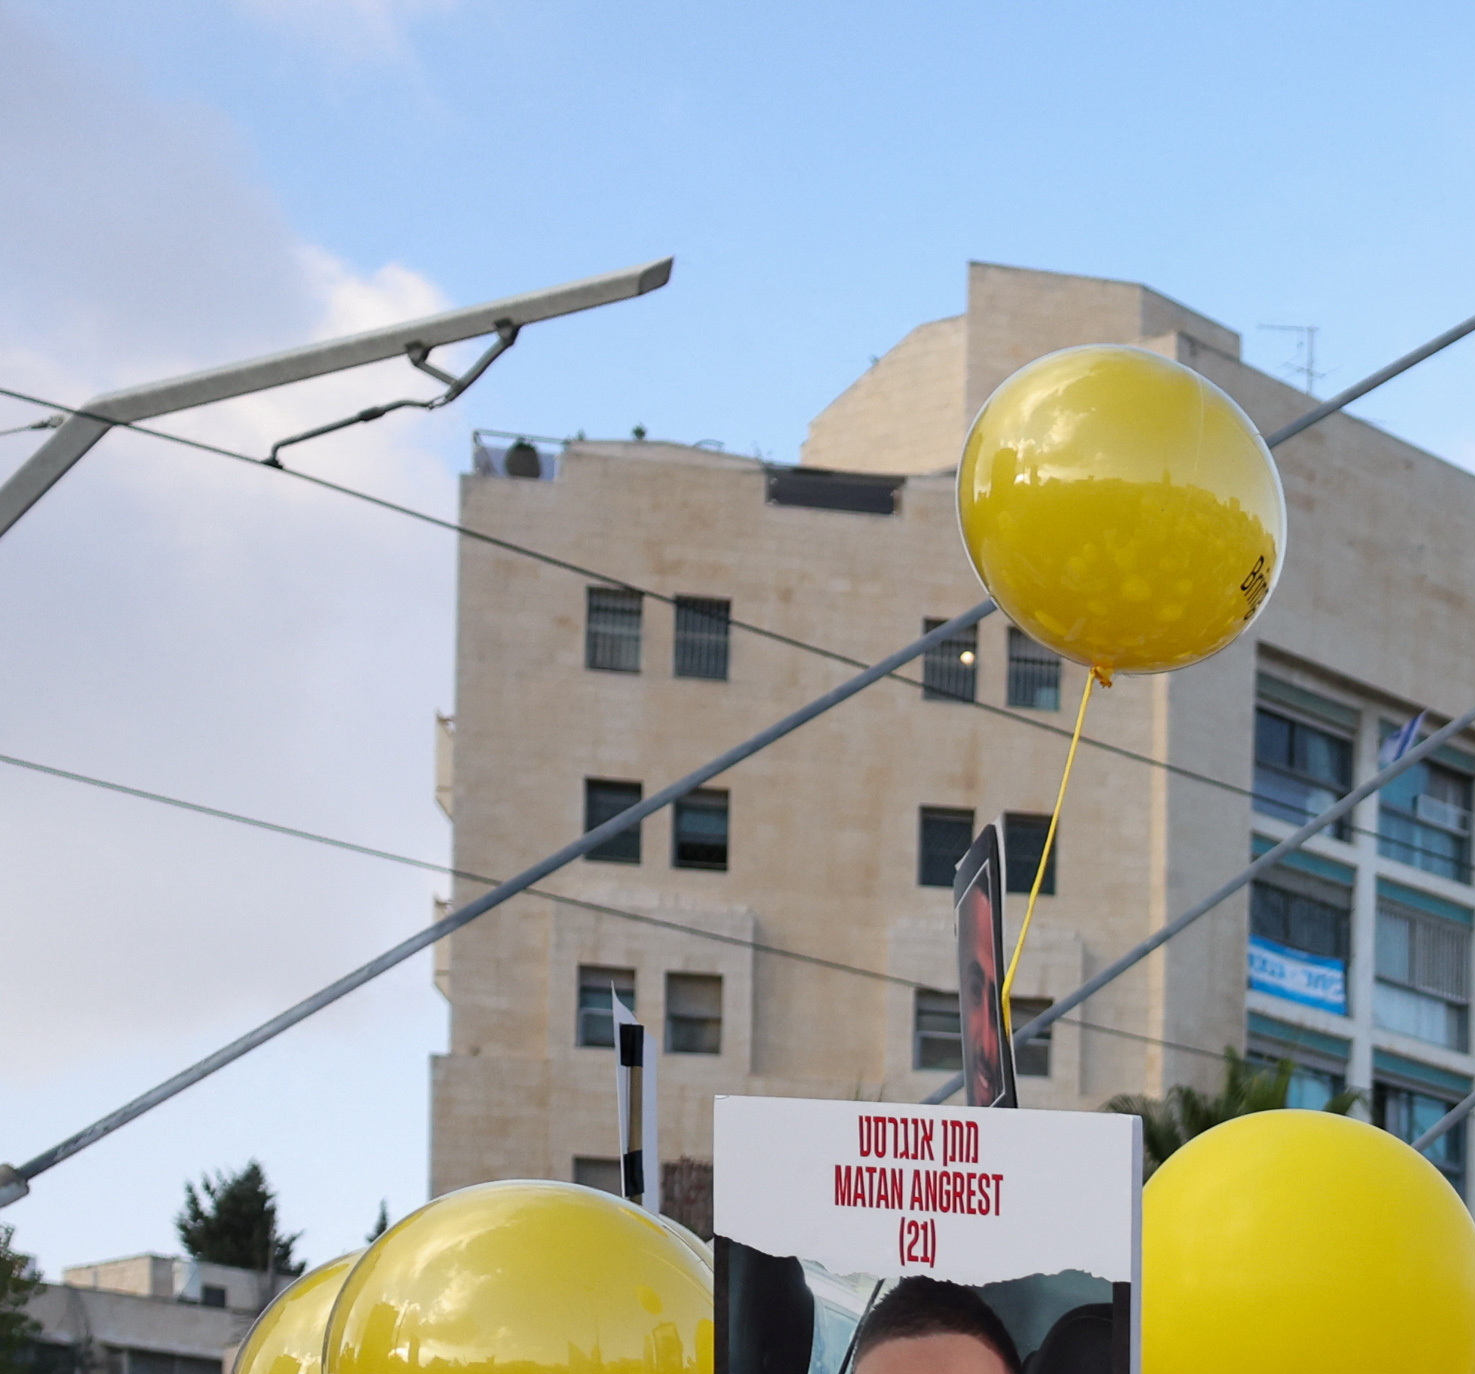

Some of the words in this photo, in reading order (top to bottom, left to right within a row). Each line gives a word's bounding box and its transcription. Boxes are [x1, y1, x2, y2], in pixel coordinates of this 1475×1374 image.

[859, 1116, 933, 1162] אנגרסט
[943, 1120, 979, 1166] מתן
[834, 1165, 902, 1210] MATAN
[911, 1170, 1003, 1216] ANGREST
[899, 1217, 936, 1267] (21)
